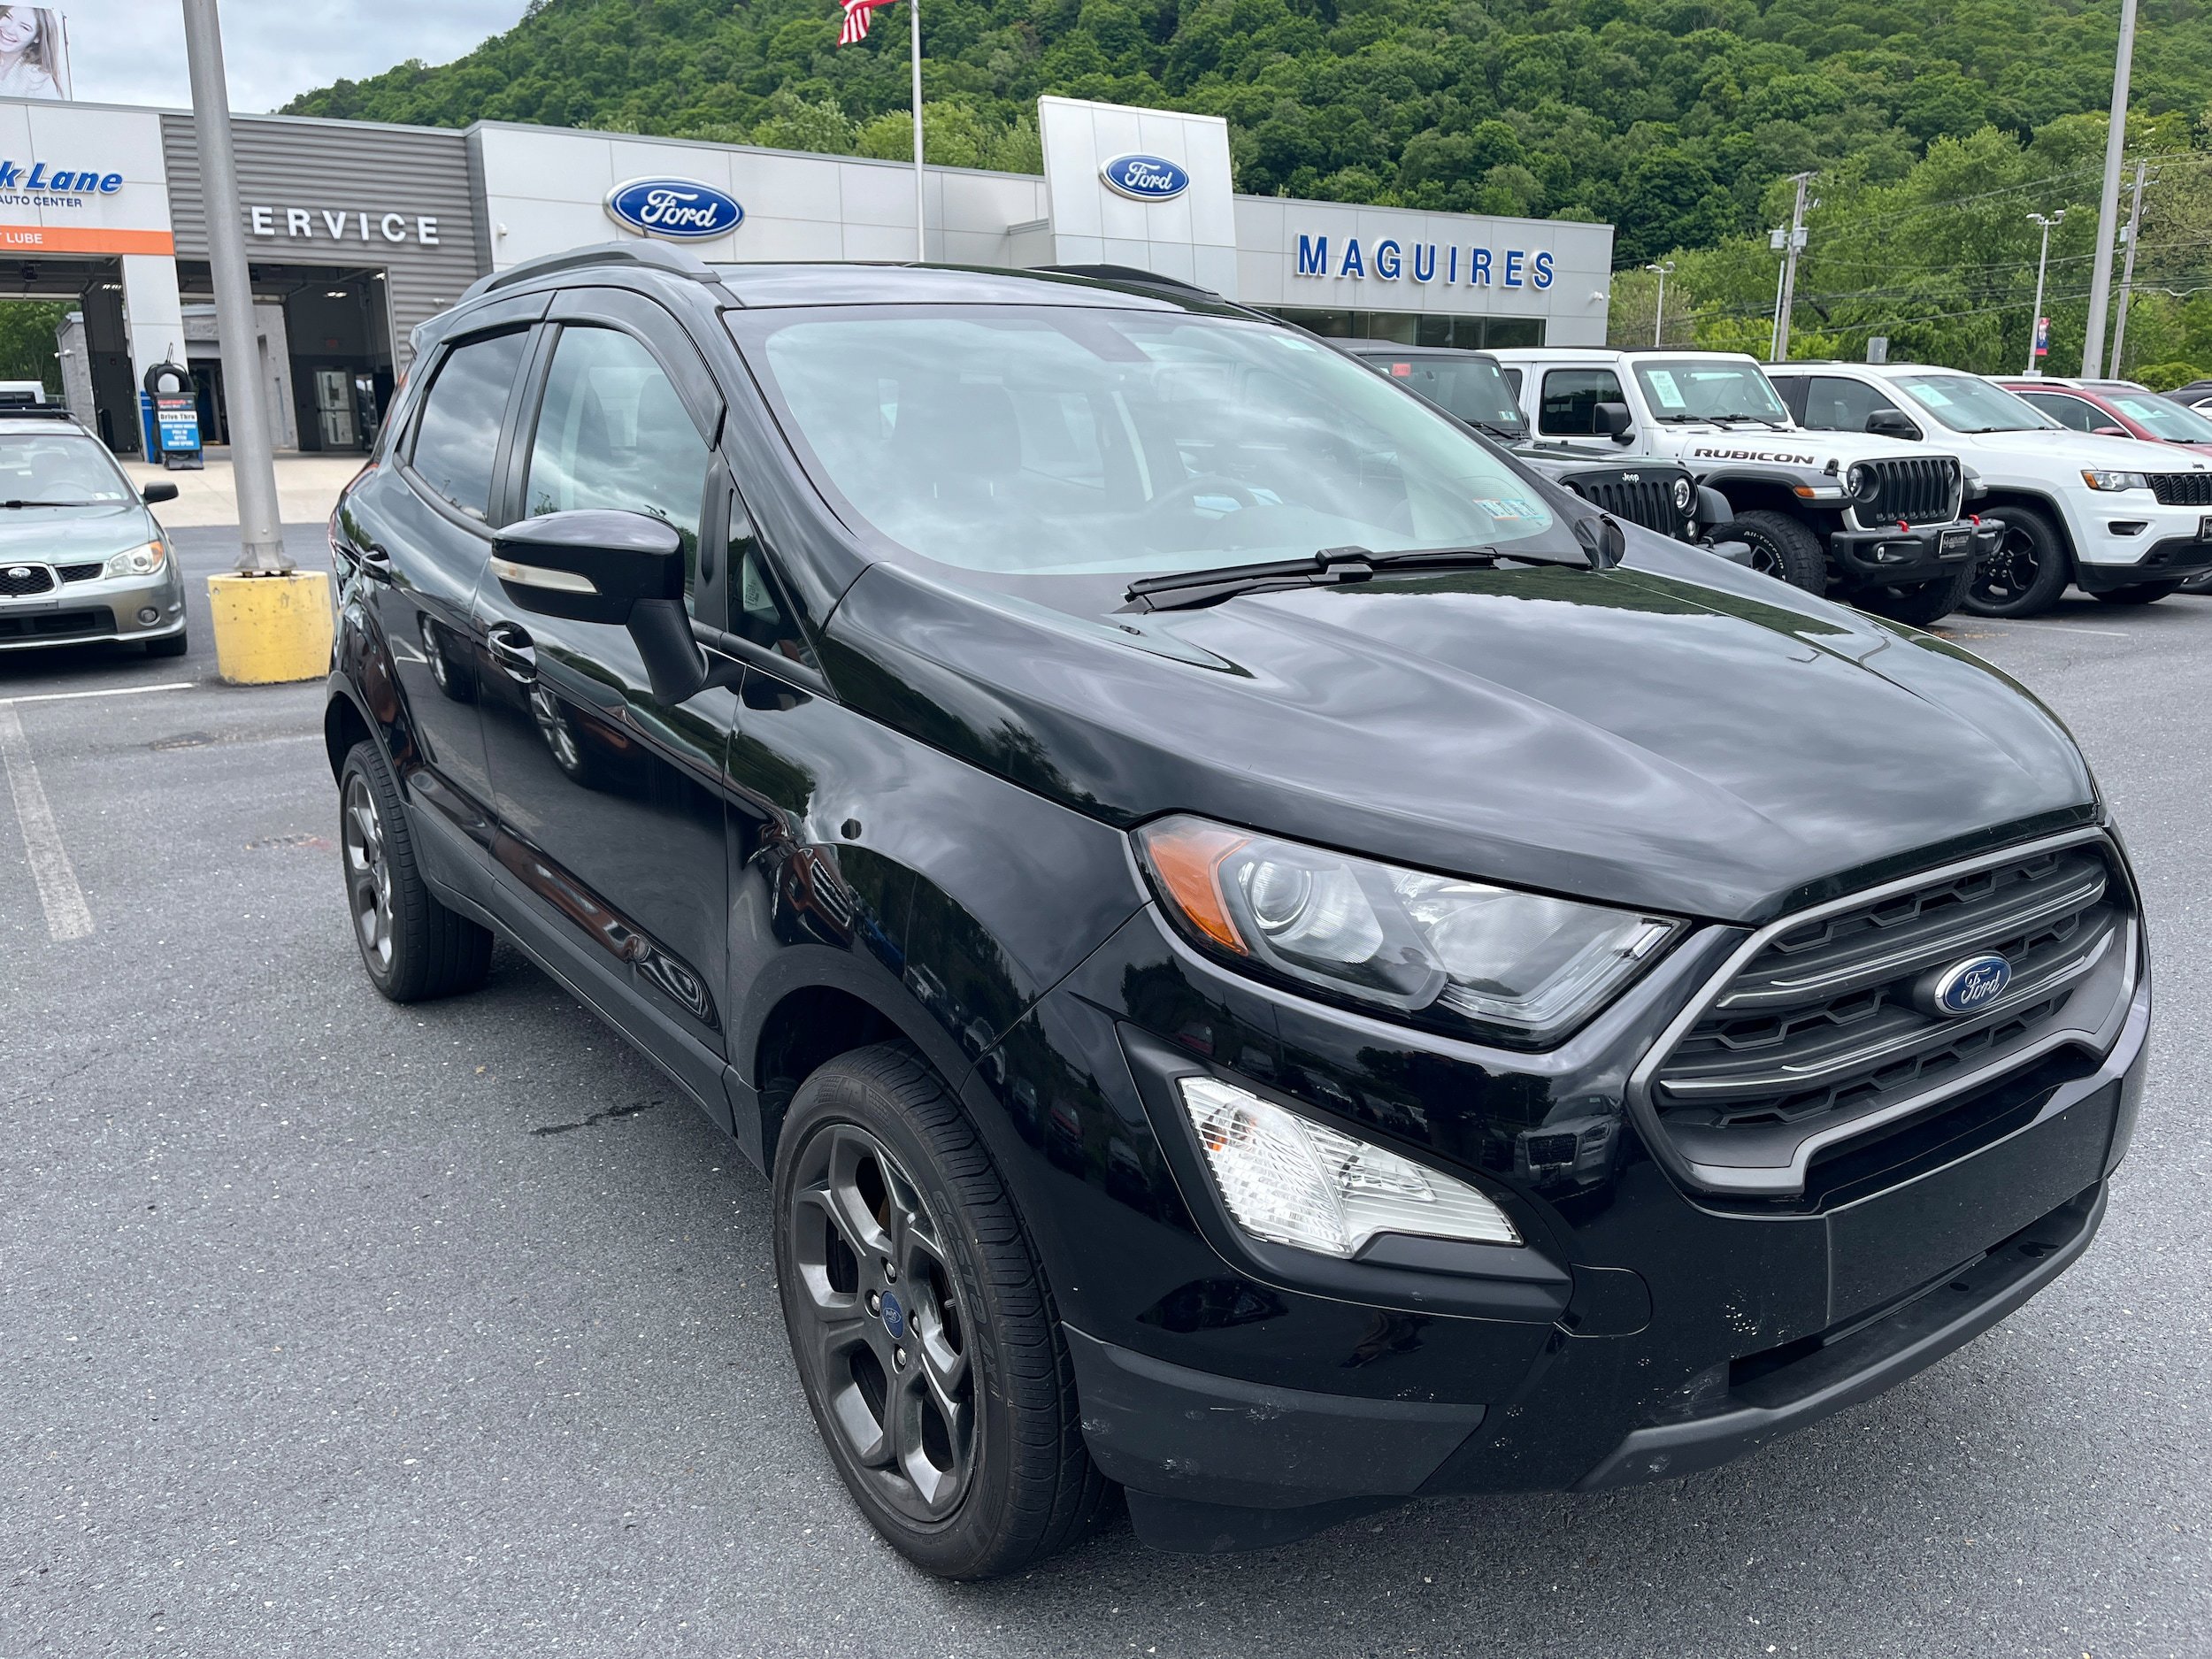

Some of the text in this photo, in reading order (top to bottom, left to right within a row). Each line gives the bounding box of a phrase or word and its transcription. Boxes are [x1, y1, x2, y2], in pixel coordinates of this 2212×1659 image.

[25, 162, 124, 194] Lane
[1124, 161, 1173, 190] Ford
[34, 196, 82, 208] CENTER
[640, 189, 718, 227] Ford
[6, 233, 43, 244] LUBE
[250, 205, 441, 245] ERVICE
[1296, 234, 1555, 290] MAGUIRES
[1694, 448, 1816, 465] RUBICON
[1621, 472, 1640, 482] Jeep
[1961, 966, 2001, 1004] Ford
